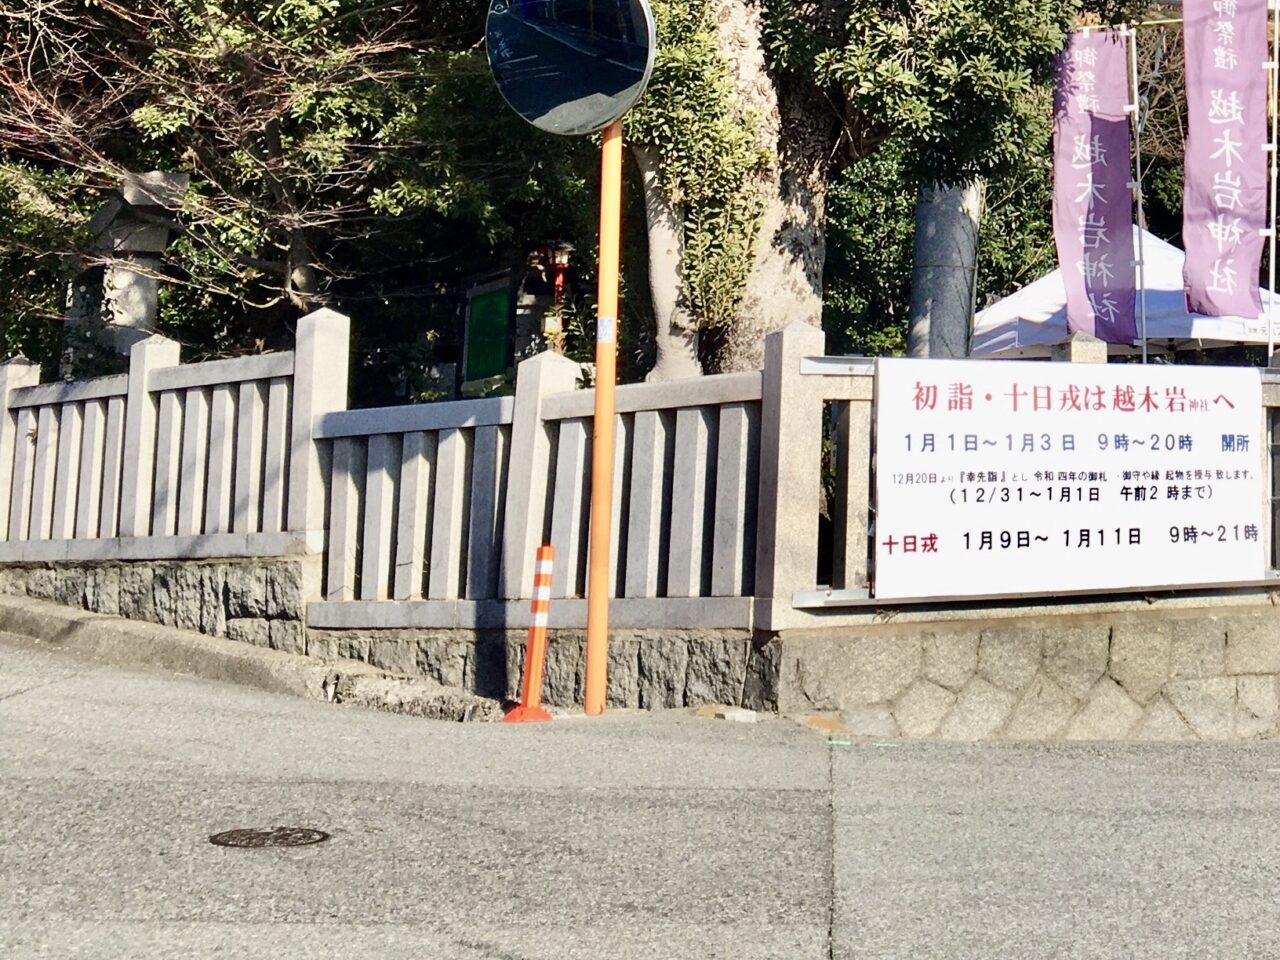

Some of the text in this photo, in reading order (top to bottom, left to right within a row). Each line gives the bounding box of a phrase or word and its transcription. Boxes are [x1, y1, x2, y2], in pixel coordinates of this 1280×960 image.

[912, 381, 1235, 413] 初詣・十日戎は越木岩神社へ
[1097, 433, 1194, 452] 9時〜20時
[1221, 434, 1250, 452] 開所
[882, 533, 939, 555] 十日戎
[1169, 524, 1259, 544] 9時〜21時
